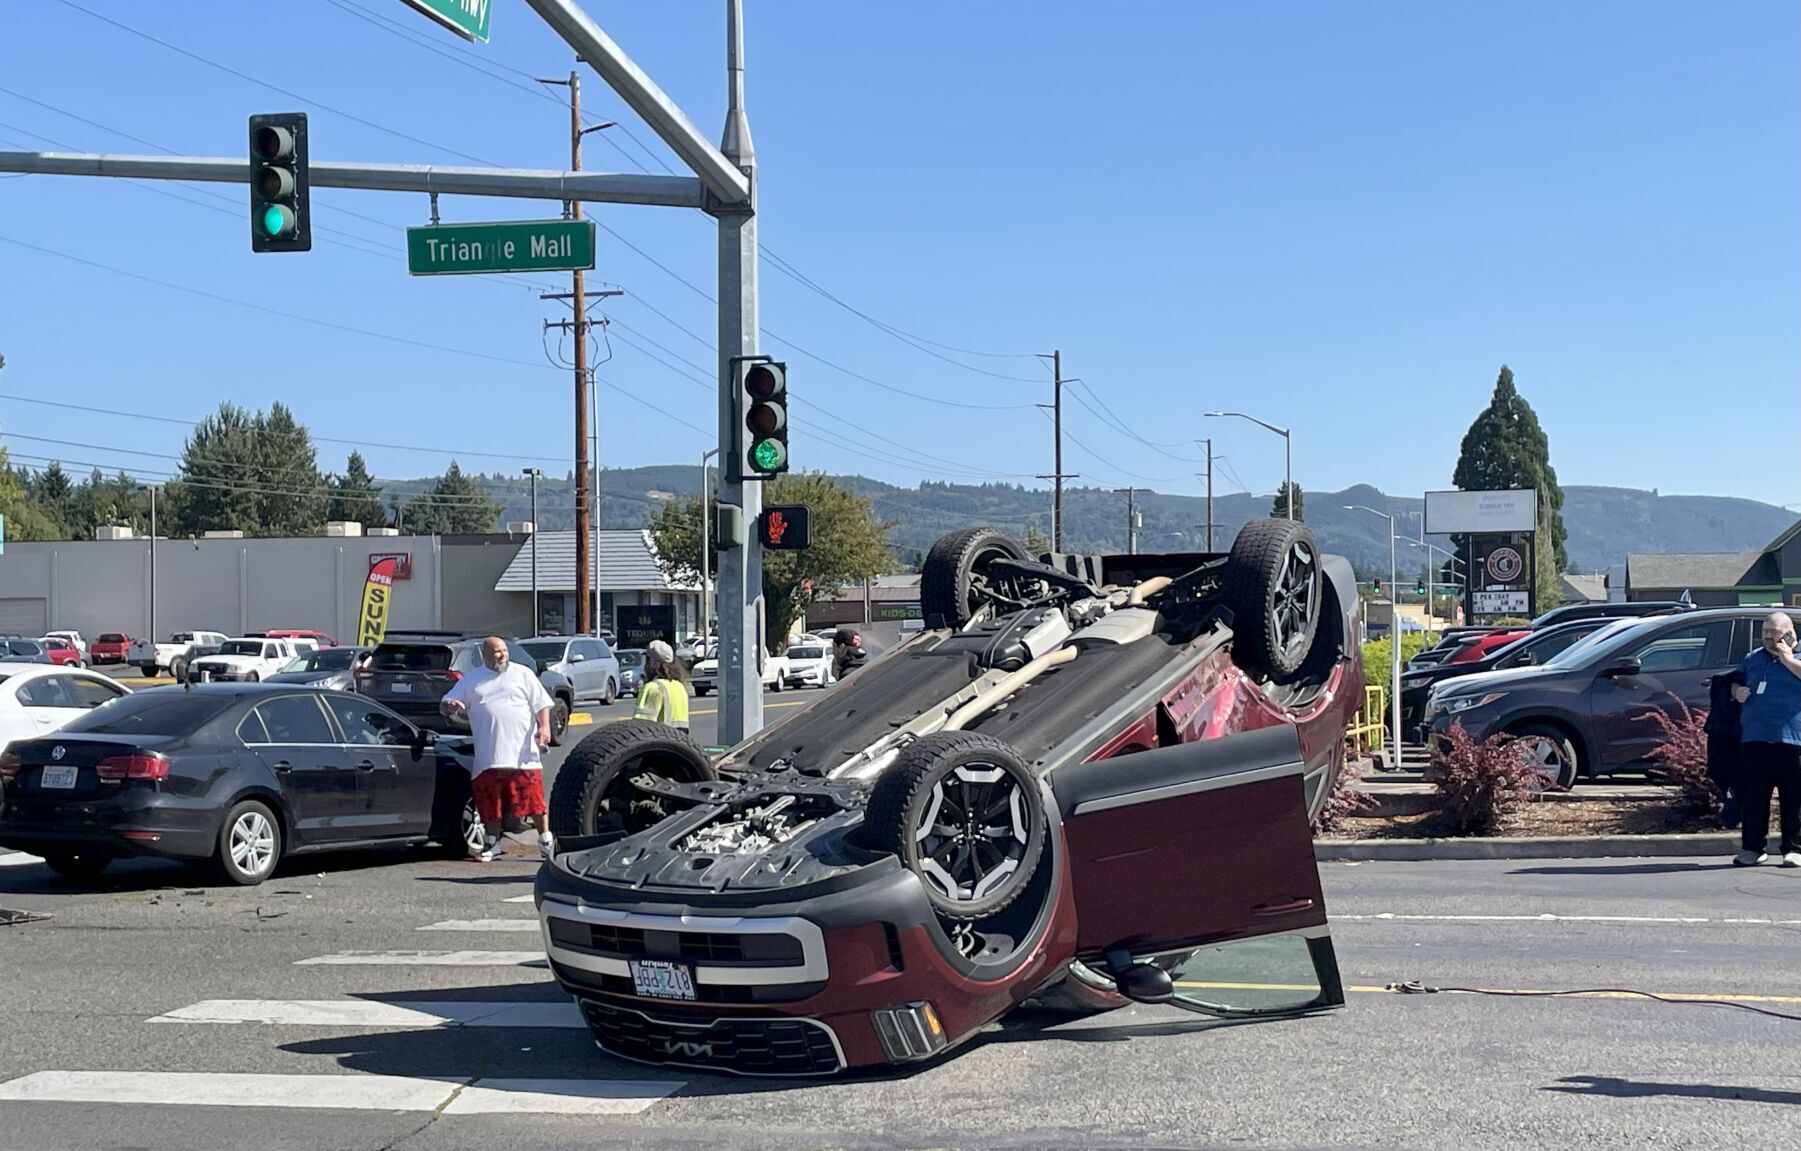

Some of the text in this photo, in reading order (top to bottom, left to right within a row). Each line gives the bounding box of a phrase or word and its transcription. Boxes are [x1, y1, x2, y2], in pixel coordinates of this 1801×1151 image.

[530, 234, 571, 258] Mall
[370, 573, 392, 585] OPEN
[626, 629, 664, 638] TEQUILA
[636, 968, 690, 991] 812 PBF
